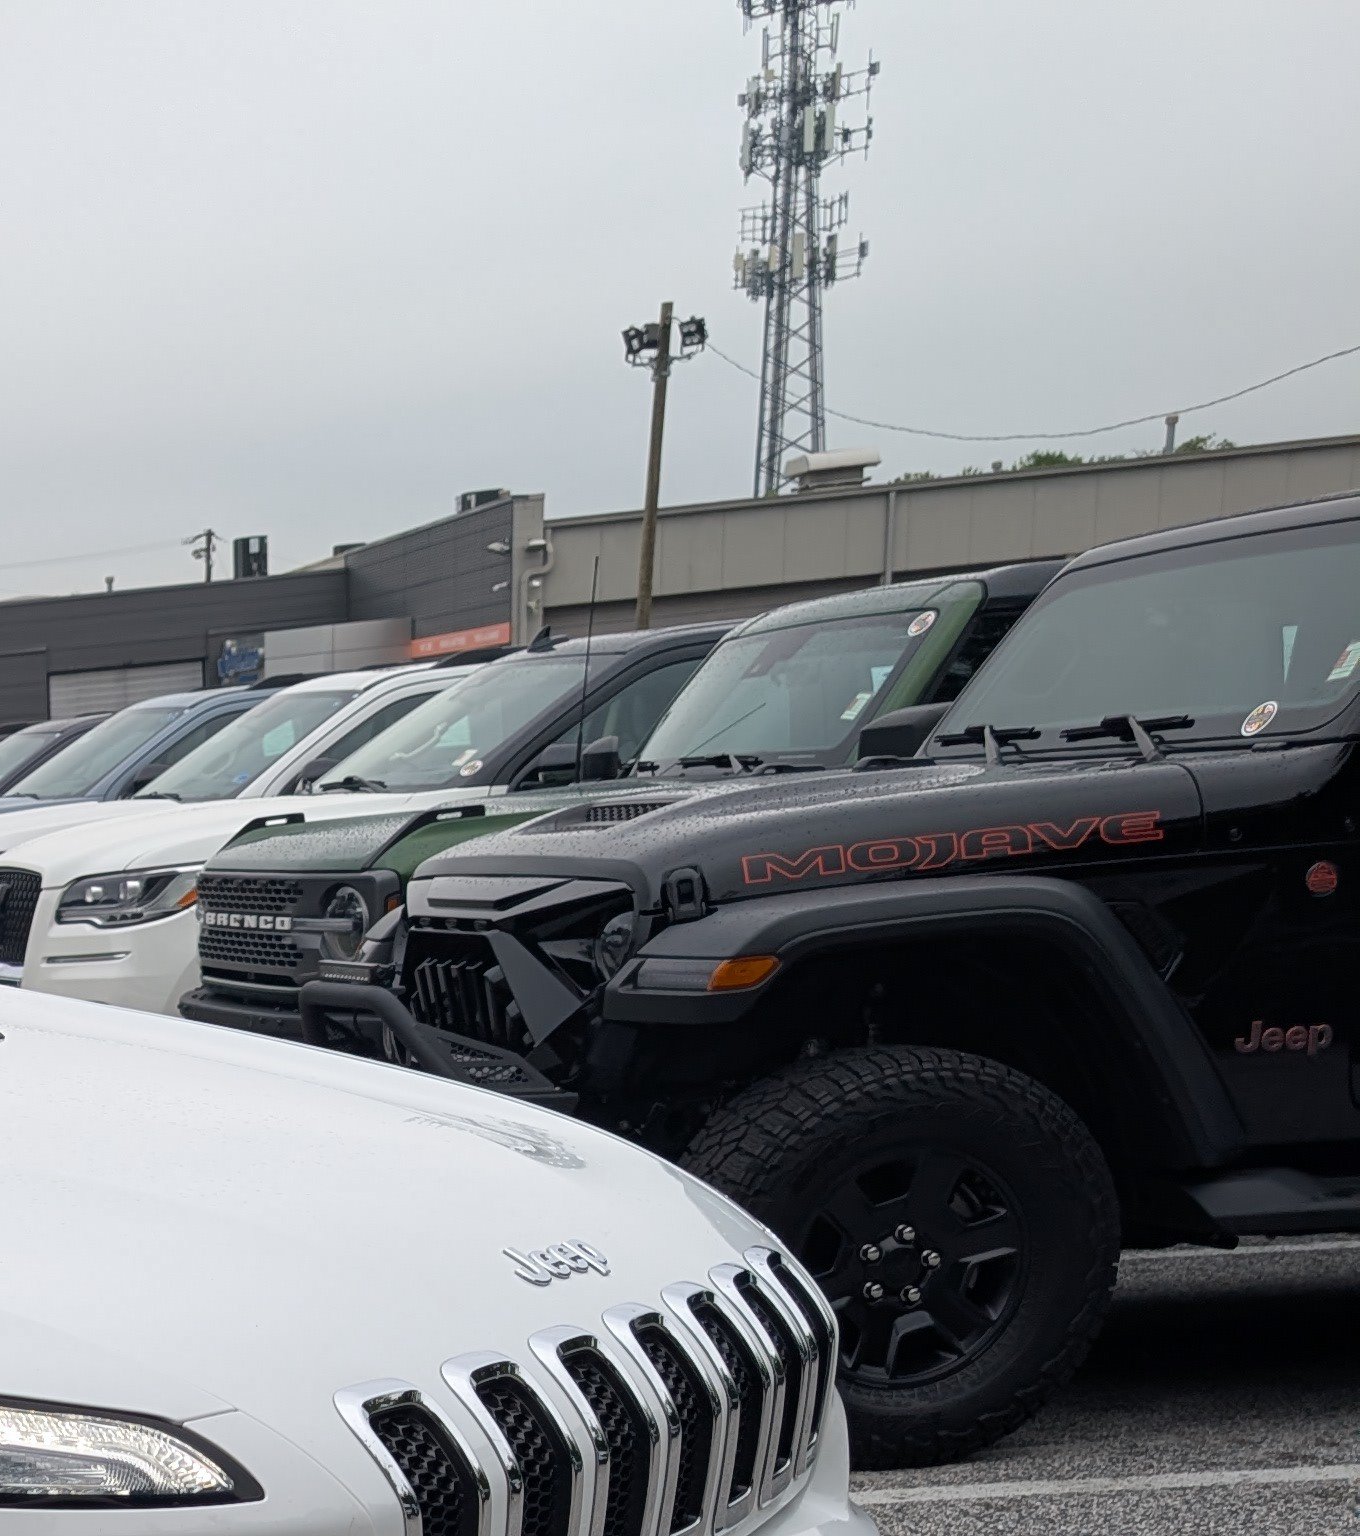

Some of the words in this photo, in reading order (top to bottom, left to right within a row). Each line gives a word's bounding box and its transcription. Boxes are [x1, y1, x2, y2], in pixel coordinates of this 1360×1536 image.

[741, 811, 1165, 884] MOJAVE
[205, 911, 293, 931] BRONCO
[1233, 1020, 1334, 1057] Jeep
[502, 1238, 612, 1288] Jeep
